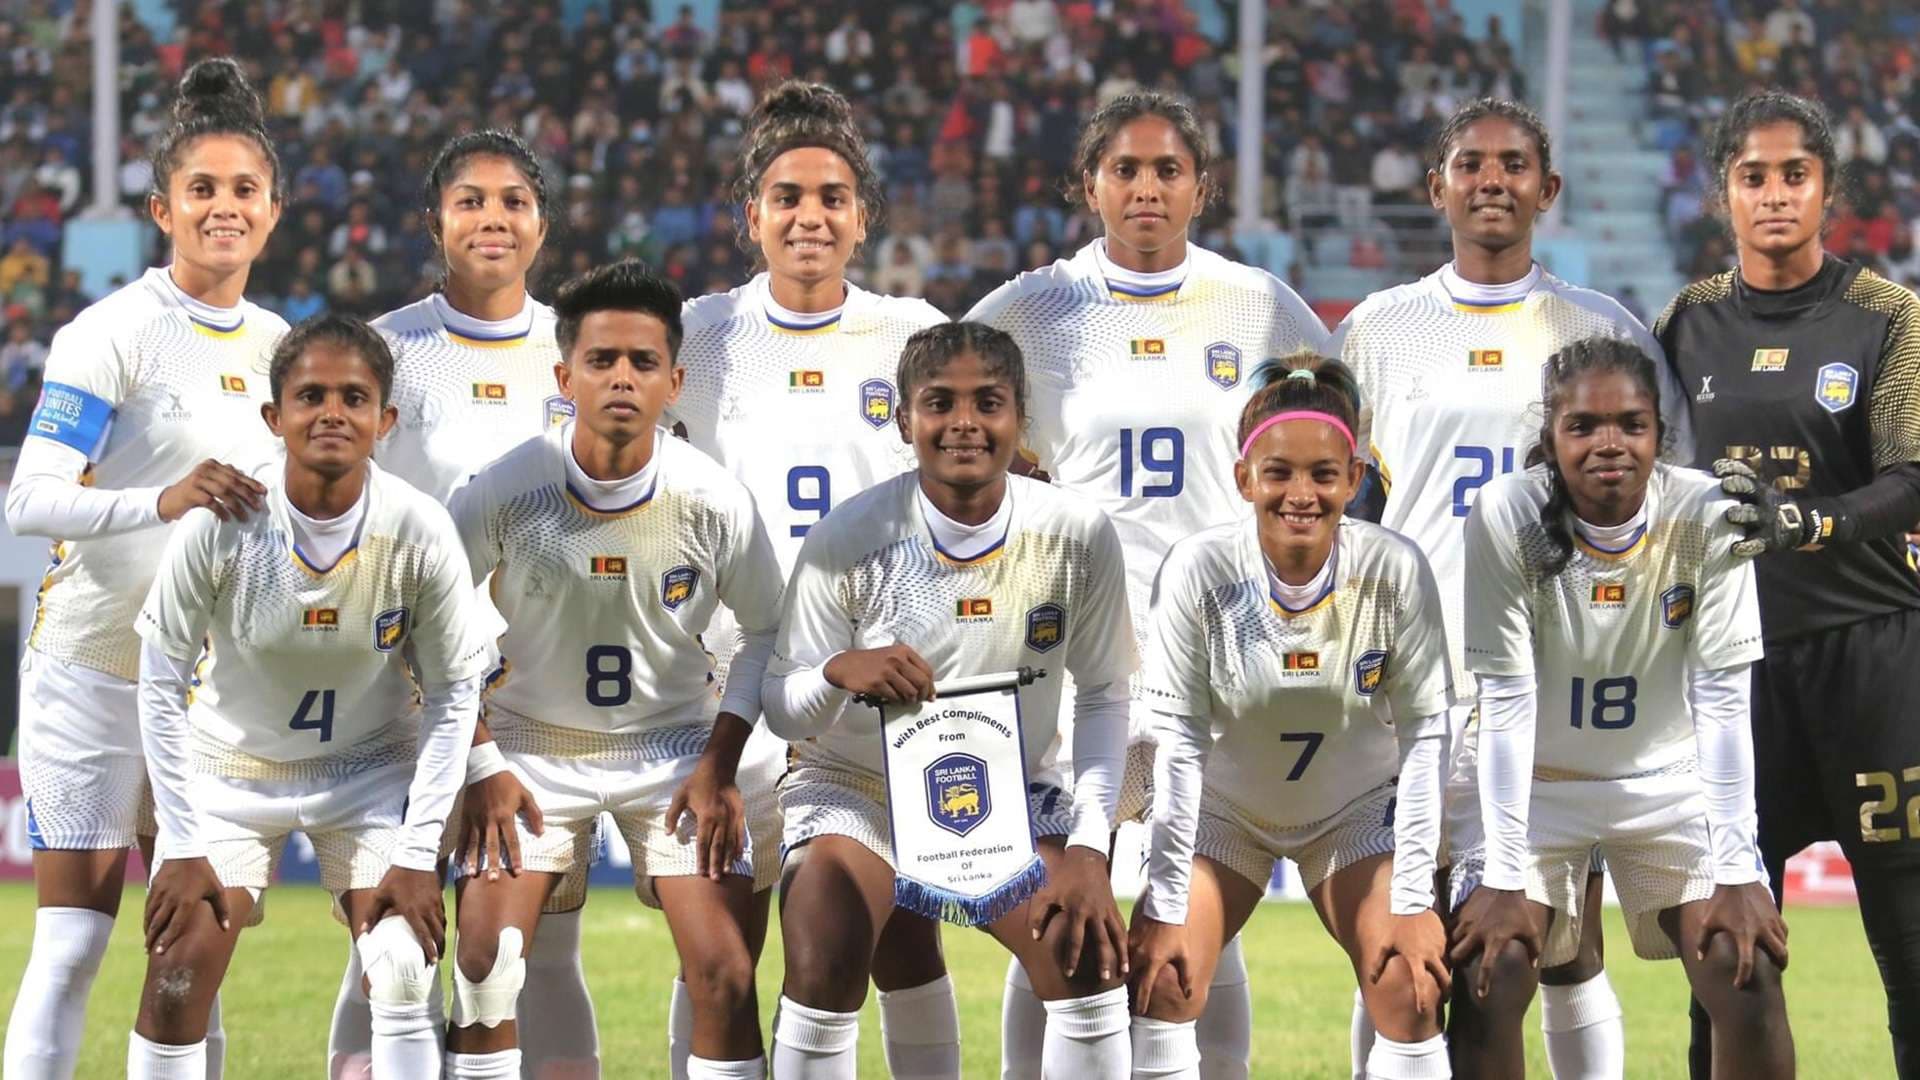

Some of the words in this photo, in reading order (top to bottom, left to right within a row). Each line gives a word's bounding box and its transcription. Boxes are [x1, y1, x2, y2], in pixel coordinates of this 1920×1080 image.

[45, 397, 82, 417] UNITES
[1120, 427, 1184, 497] 19
[787, 465, 831, 538] 9
[586, 644, 632, 707] 8
[1295, 670, 1320, 678] LANKA
[289, 689, 335, 742] 4
[1570, 675, 1638, 730] 18
[893, 728, 916, 748] With
[916, 713, 940, 730] Best
[942, 709, 1012, 738] Compliments
[938, 732, 966, 742] From
[949, 765, 976, 775] LANKA
[1280, 732, 1325, 781] 7
[936, 772, 977, 784] FOOTBALL
[917, 850, 958, 862] Football
[960, 844, 1013, 857] Federation
[962, 872, 992, 882] Lanka
